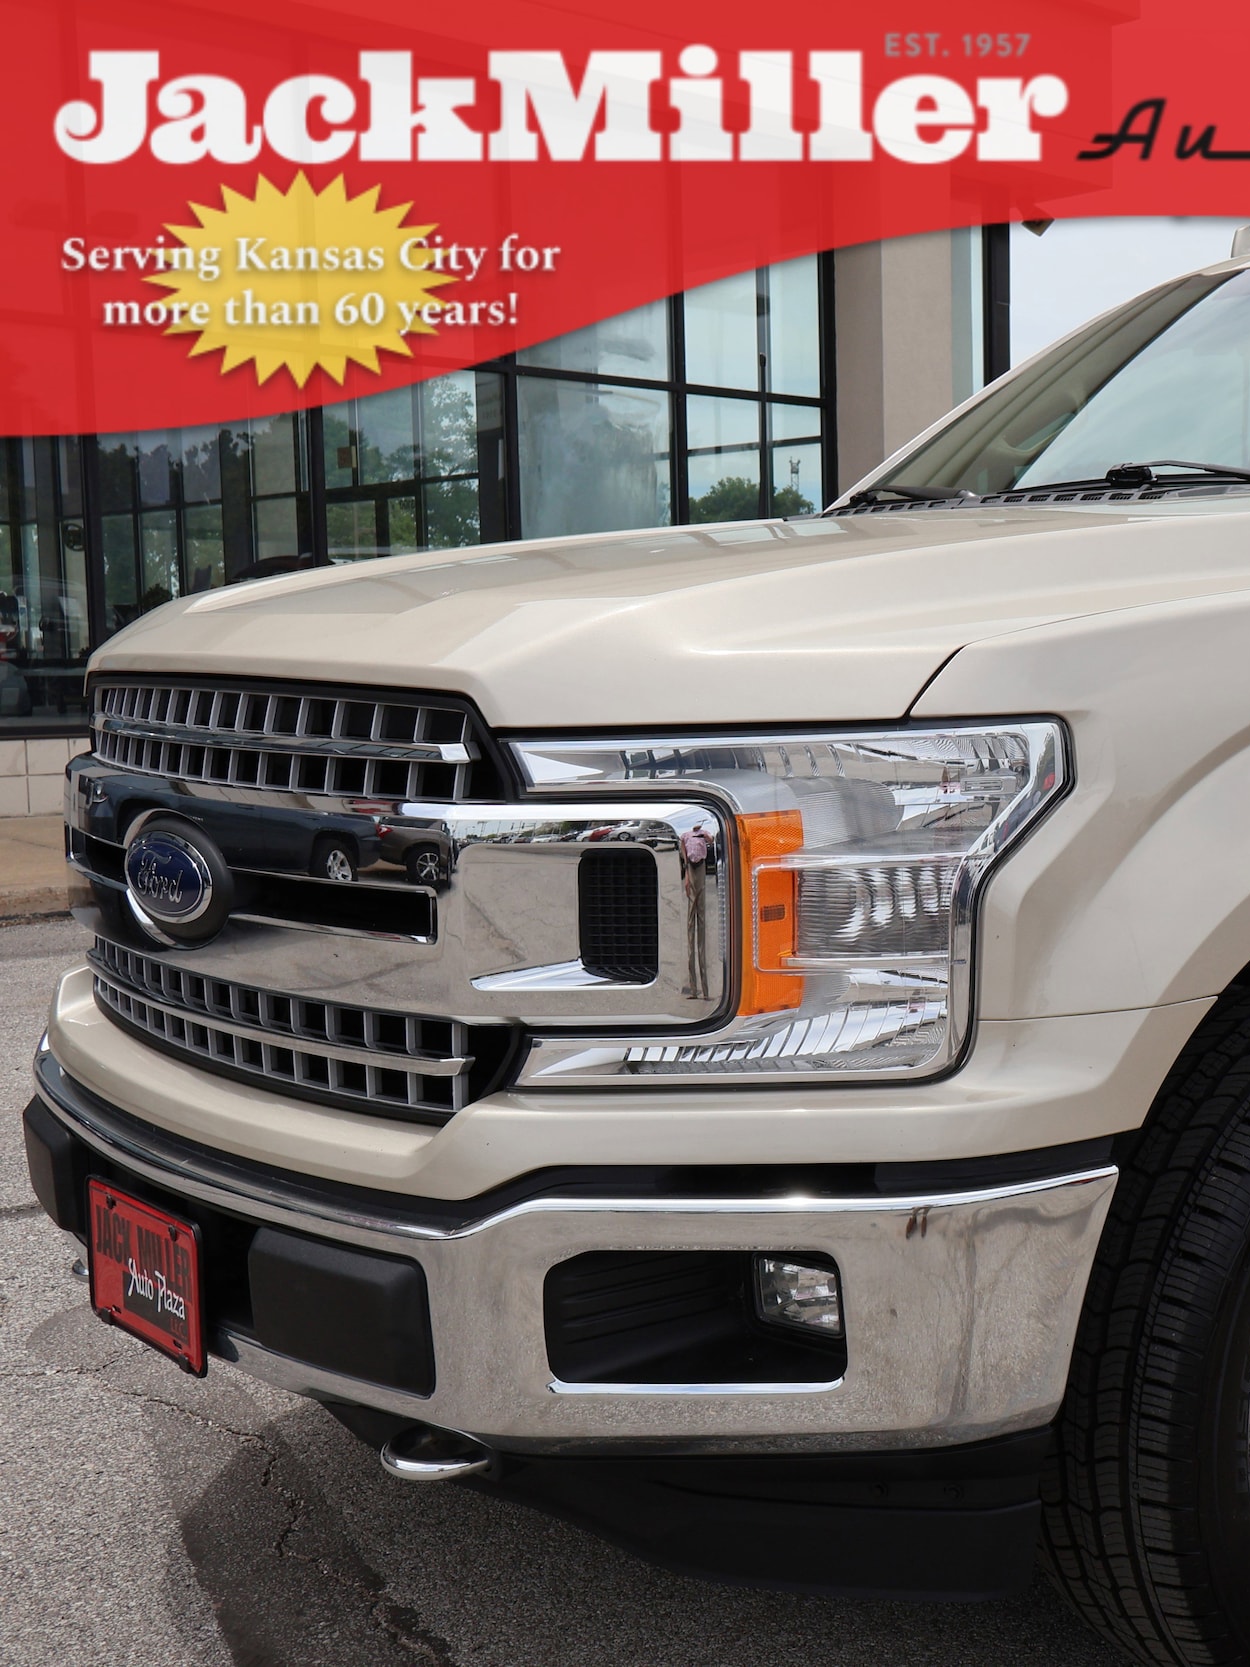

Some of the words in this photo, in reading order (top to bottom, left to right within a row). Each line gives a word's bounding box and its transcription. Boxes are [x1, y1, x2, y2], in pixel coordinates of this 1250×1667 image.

[137, 850, 184, 904] Ford
[95, 1204, 132, 1266] JACK
[136, 1223, 193, 1304] MILLER
[126, 1257, 154, 1300] Auto
[154, 1270, 186, 1320] Plaza
